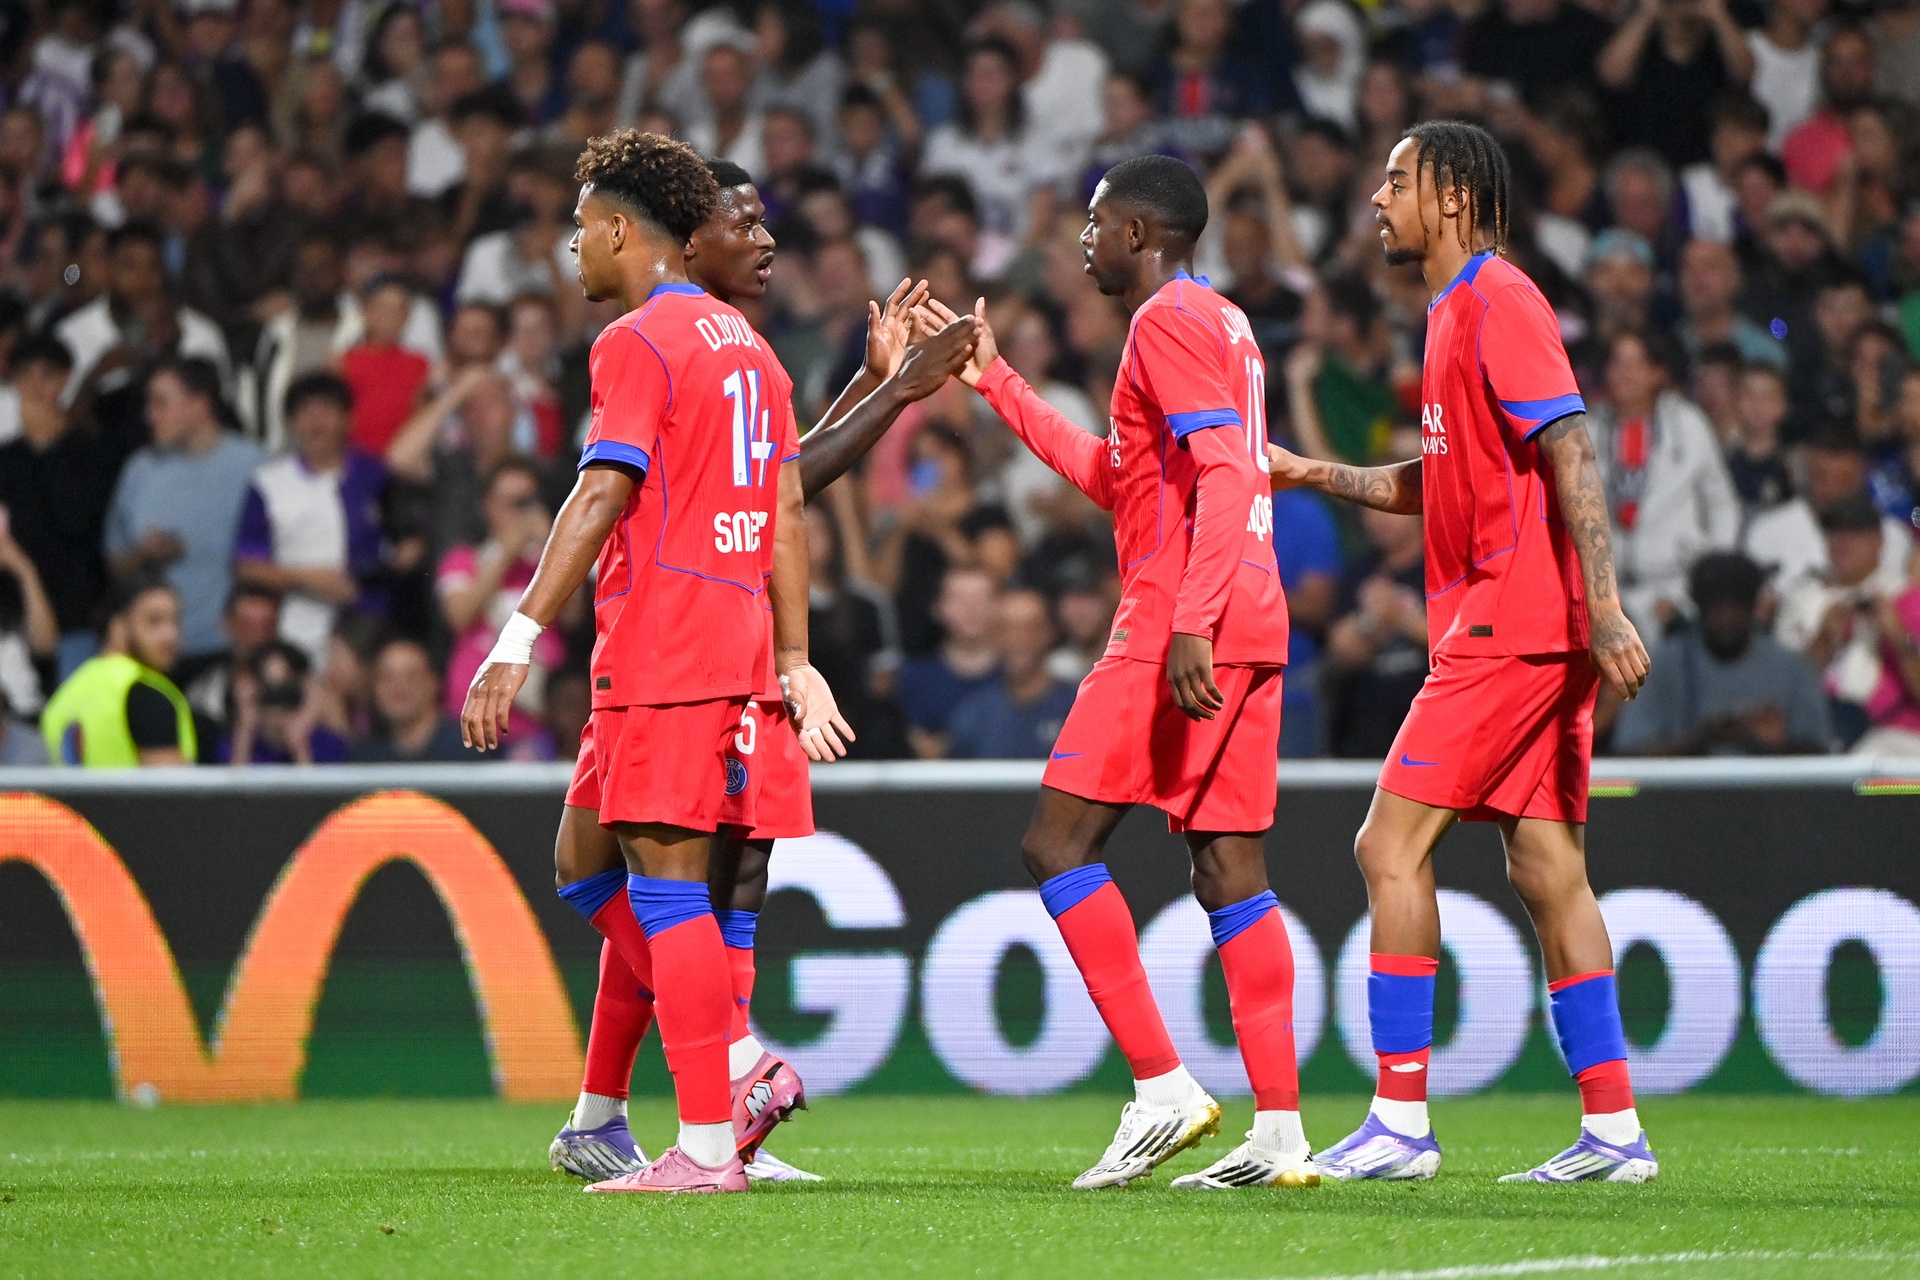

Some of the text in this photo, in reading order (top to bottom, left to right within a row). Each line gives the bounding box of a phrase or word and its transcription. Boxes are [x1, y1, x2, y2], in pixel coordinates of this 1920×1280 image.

[723, 368, 778, 487] 14
[1245, 354, 1270, 474] 10
[725, 760, 742, 771] ARIS
[734, 701, 758, 755] 5
